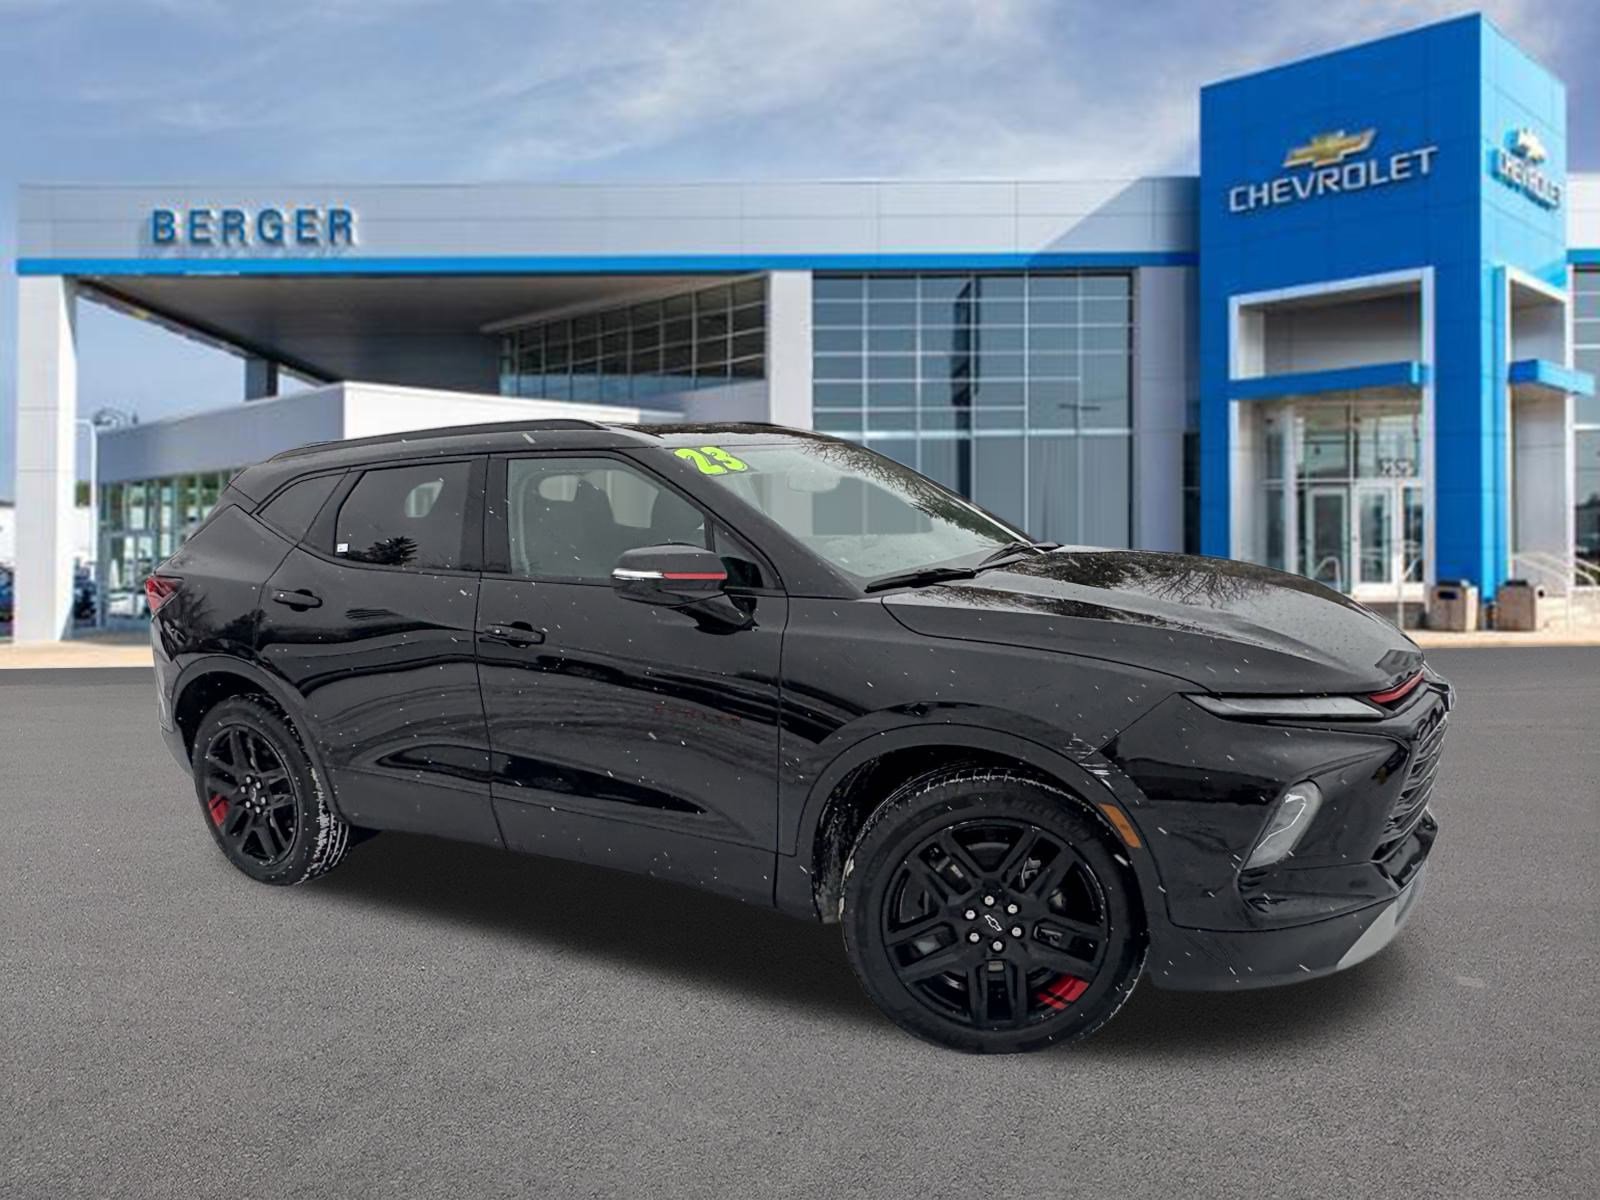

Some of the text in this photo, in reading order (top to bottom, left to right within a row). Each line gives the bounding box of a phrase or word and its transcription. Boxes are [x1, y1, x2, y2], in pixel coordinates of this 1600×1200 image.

[1229, 146, 1437, 212] CHEVROLET
[152, 207, 357, 246] BERGER
[674, 446, 748, 475] 23
